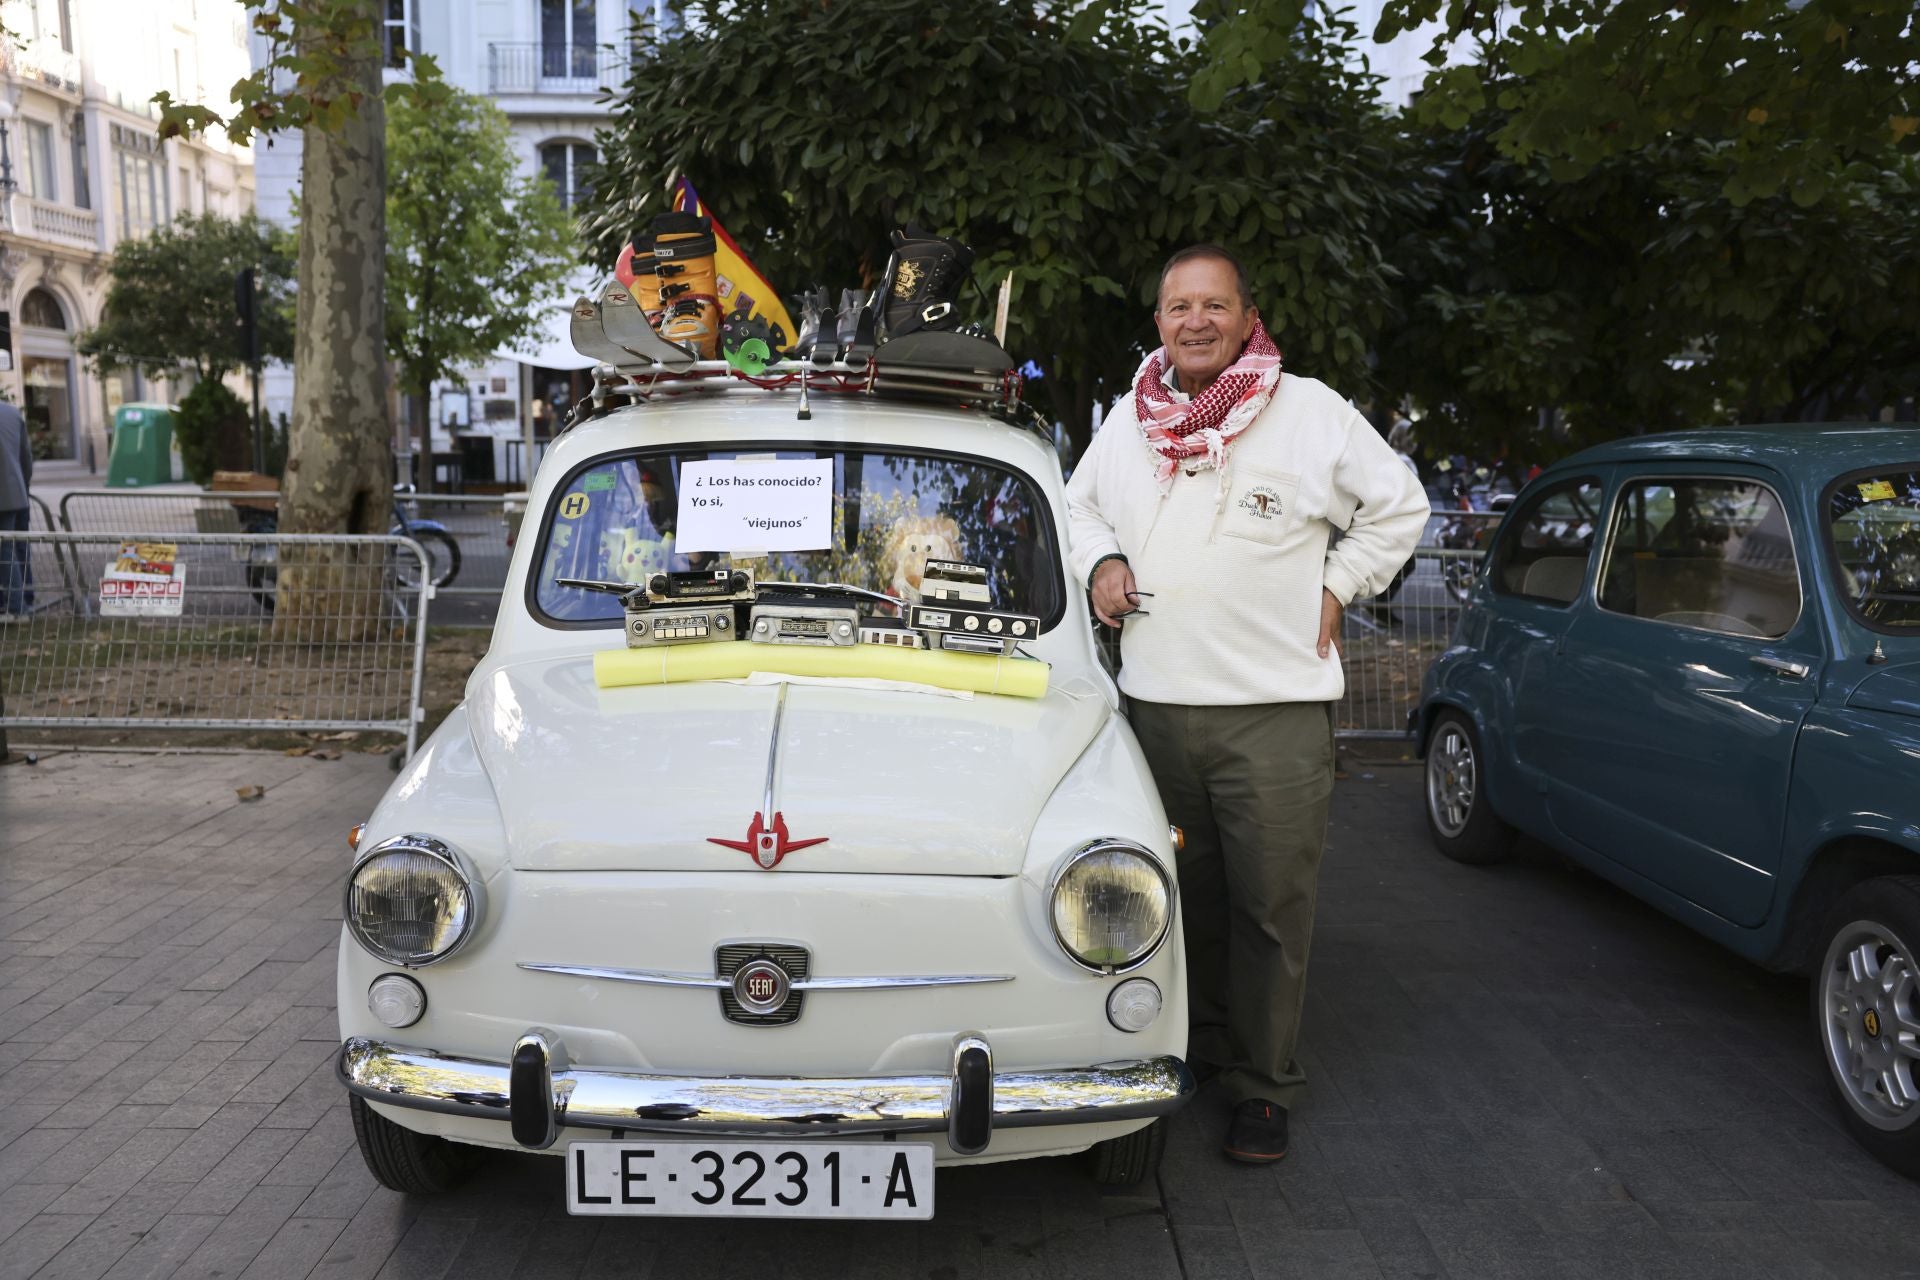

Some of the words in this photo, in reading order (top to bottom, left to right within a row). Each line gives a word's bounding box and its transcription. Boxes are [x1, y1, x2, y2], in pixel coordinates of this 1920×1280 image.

[709, 476, 730, 486] Los
[733, 476, 755, 487] has
[758, 476, 822, 487] conocido?
[565, 497, 585, 515] H
[691, 497, 707, 507] Yo
[710, 496, 724, 508] si,
[1238, 499, 1258, 510] Duck
[1267, 506, 1282, 515] Club
[749, 979, 774, 996] SEAT
